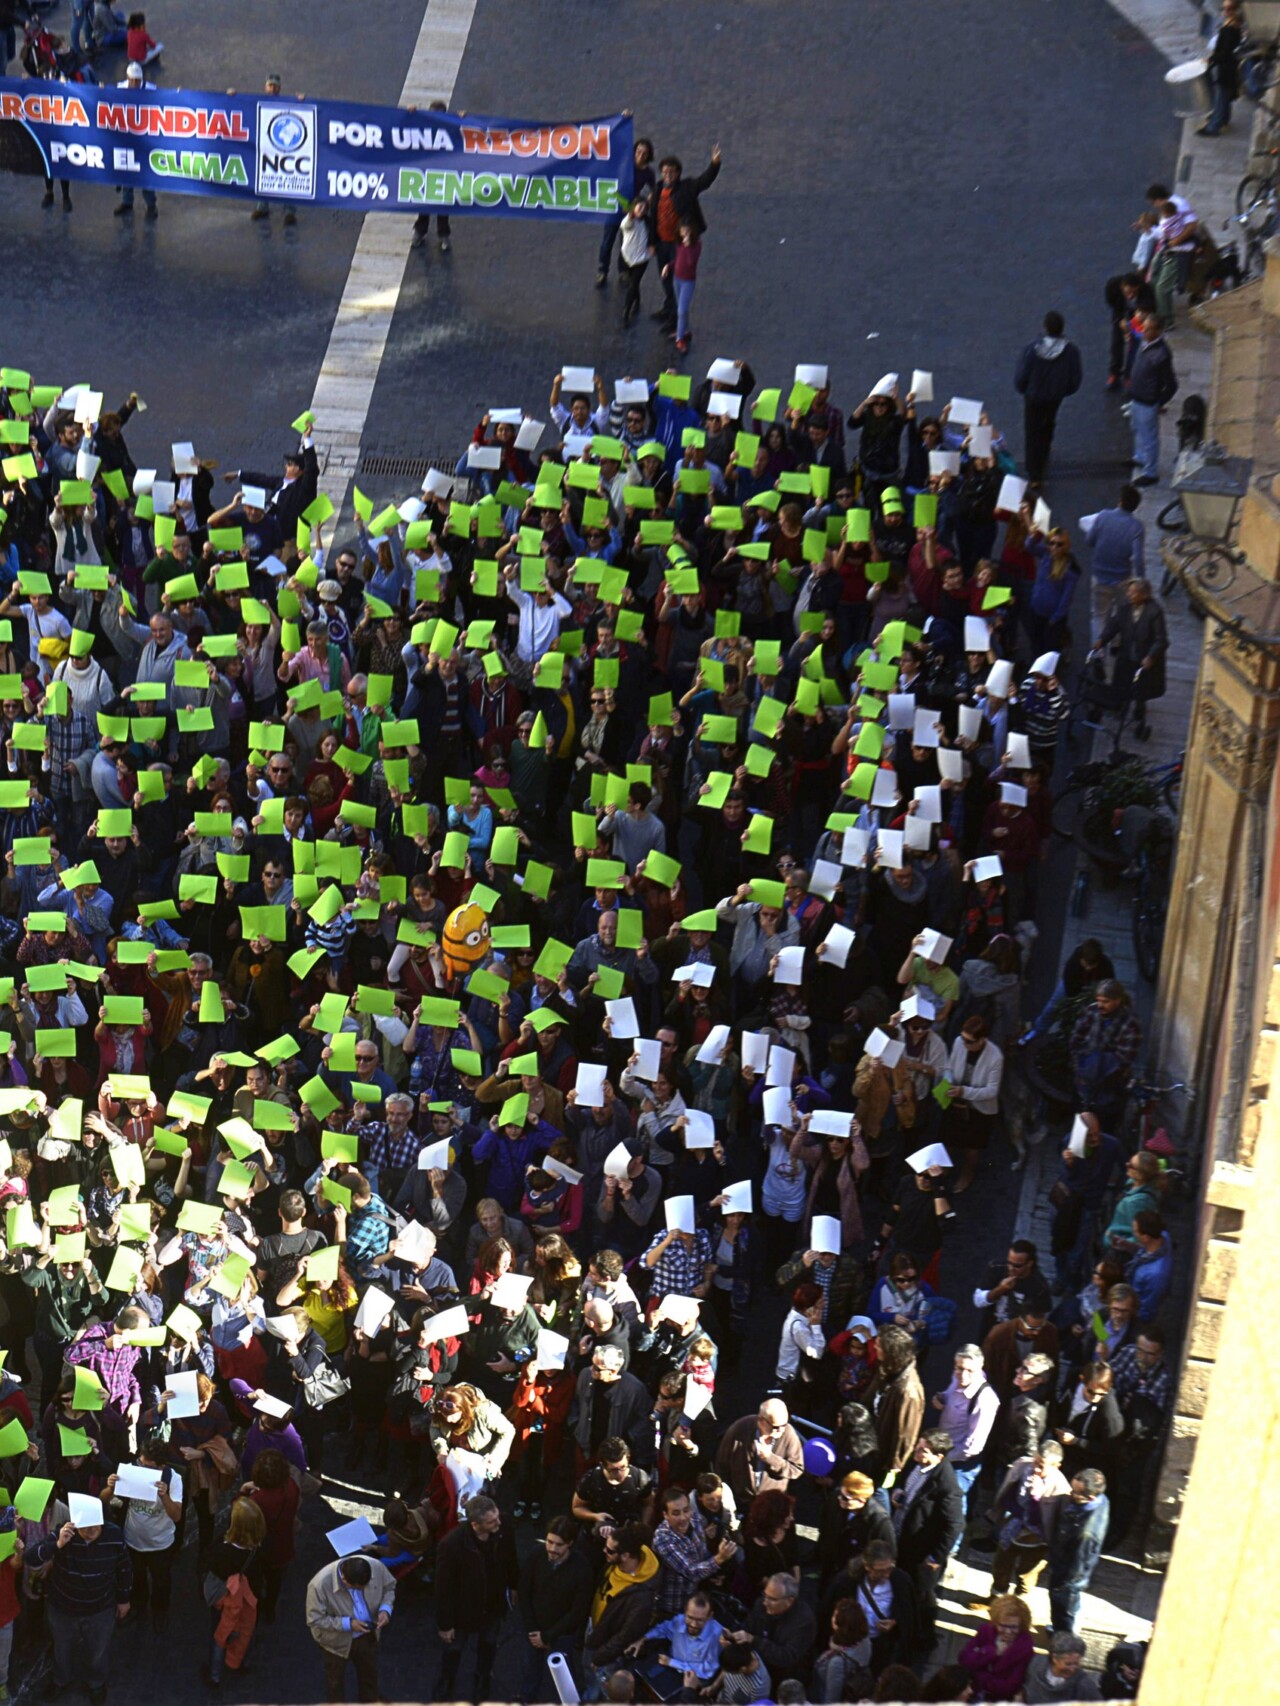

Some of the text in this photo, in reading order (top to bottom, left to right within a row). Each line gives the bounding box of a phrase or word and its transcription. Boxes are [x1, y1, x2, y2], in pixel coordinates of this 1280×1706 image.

[96, 101, 249, 142] MUNDIAL
[329, 120, 610, 161] POR UNA REGION
[50, 141, 249, 186] POR EL CLIMA
[262, 154, 310, 175] NCC
[327, 167, 618, 214] 100% RENOVABLE
